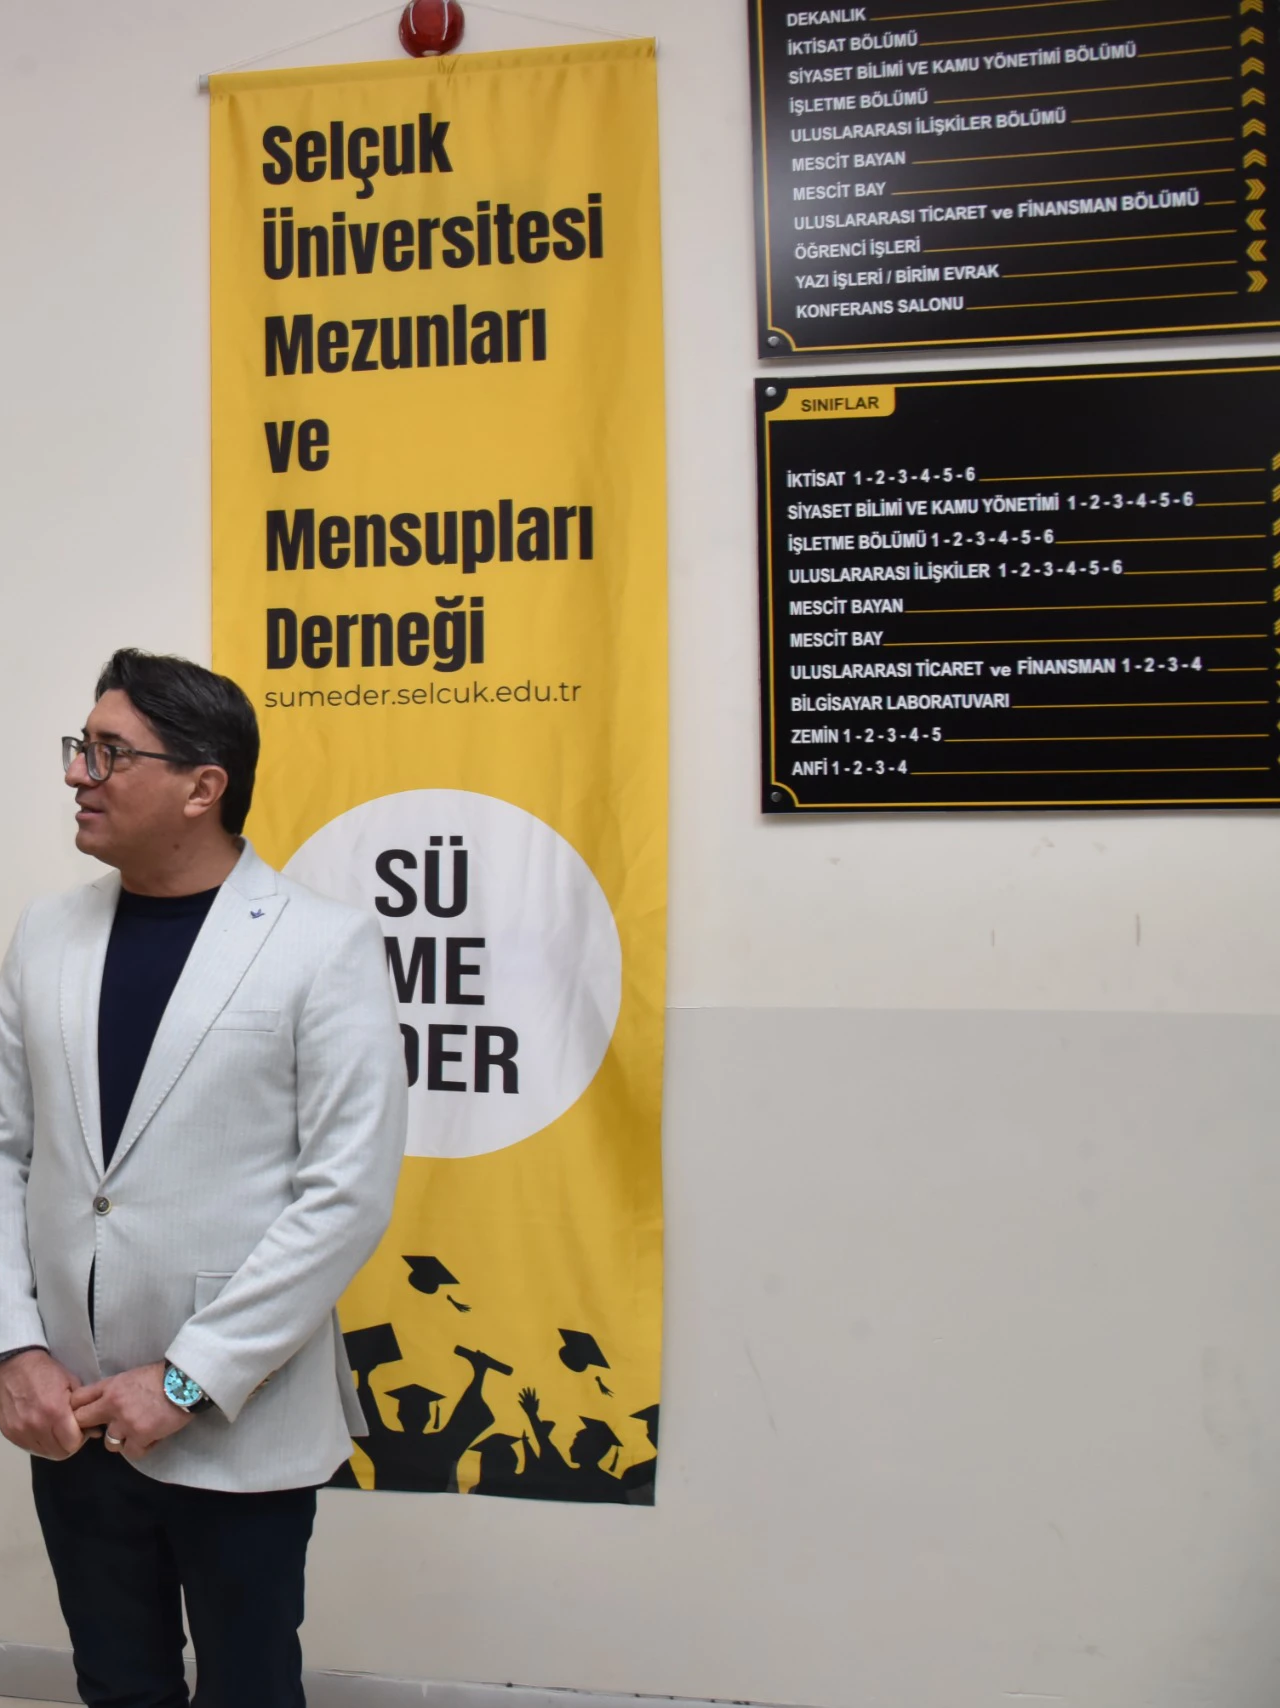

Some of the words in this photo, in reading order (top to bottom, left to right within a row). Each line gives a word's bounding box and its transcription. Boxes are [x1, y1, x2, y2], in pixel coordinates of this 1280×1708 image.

[787, 8, 866, 26] DEKANLIK
[788, 38, 846, 55] İKTİSAT
[850, 30, 917, 50] BÖLÜMÜ
[789, 67, 853, 84] SİYASET
[857, 60, 903, 79] BİLİMİ
[907, 61, 928, 75] VE
[932, 57, 979, 73] KAMU
[983, 47, 1060, 69] YÖNETİMİ
[1065, 41, 1136, 63] BÖLÜMÜ
[790, 96, 856, 116] İŞLETME
[860, 88, 927, 108] BÖLÜMÜ
[791, 122, 911, 142] ULUSLARARASI
[916, 115, 992, 136] İLİŞKİLER
[996, 107, 1066, 128] BÖLÜMÜ
[263, 113, 453, 199] Selçuk
[792, 153, 849, 171] MESCİT
[854, 151, 905, 167] BAYAN
[793, 182, 850, 200] MESCİT
[855, 182, 885, 197] BAY
[794, 210, 914, 230] ULUSLARARASI
[918, 205, 987, 222] TİCARET
[991, 208, 1013, 219] ve
[1018, 197, 1117, 218] FİNANSMAN
[1122, 188, 1199, 210] BÖLÜMÜ
[264, 188, 603, 280] Üniversitesi
[795, 240, 866, 259] ÖĞRENCİ
[870, 236, 920, 258] İŞLERİ
[795, 274, 829, 288] YAZI
[833, 268, 882, 290] İŞLERİ
[895, 265, 939, 283] BİRİM
[944, 264, 999, 280] EVRAK
[797, 300, 893, 318] KONFERANS
[898, 296, 963, 313] SALONU
[265, 304, 546, 377] Mezunları
[801, 397, 879, 412] SINIFLAR
[264, 419, 329, 473] ve
[788, 469, 845, 487] İKTİSAT
[788, 502, 852, 519] SİYASET
[856, 498, 902, 517] BİLİMİ
[906, 501, 927, 515] VE
[932, 499, 978, 514] KAMU
[982, 493, 1059, 512] YÖNETİMİ
[266, 499, 593, 574] Mensupları
[789, 534, 854, 555] İŞLETME
[859, 530, 926, 549] BÖLÜMÜ
[790, 566, 910, 583] ULUSLARARASI
[914, 561, 990, 583] İLİŞKİLER
[790, 597, 847, 615] MESCİT
[852, 599, 903, 613] BAYAN
[267, 595, 484, 672] Derneği
[790, 629, 848, 647] MESCİT
[852, 631, 883, 646] BAY
[791, 663, 911, 679] ULUSLARARASI
[915, 659, 984, 676] TİCARET
[990, 666, 1011, 676] ve
[1018, 657, 1115, 674] FİNANSMAN
[265, 680, 581, 707] sumeder.selcuk.edu.tr
[792, 693, 883, 711] BİLGİSAYAR
[887, 693, 1009, 710] LABORATUVARI
[791, 726, 838, 743] ZEMİN
[792, 758, 827, 775] ANFİ
[375, 836, 467, 918] SÜ
